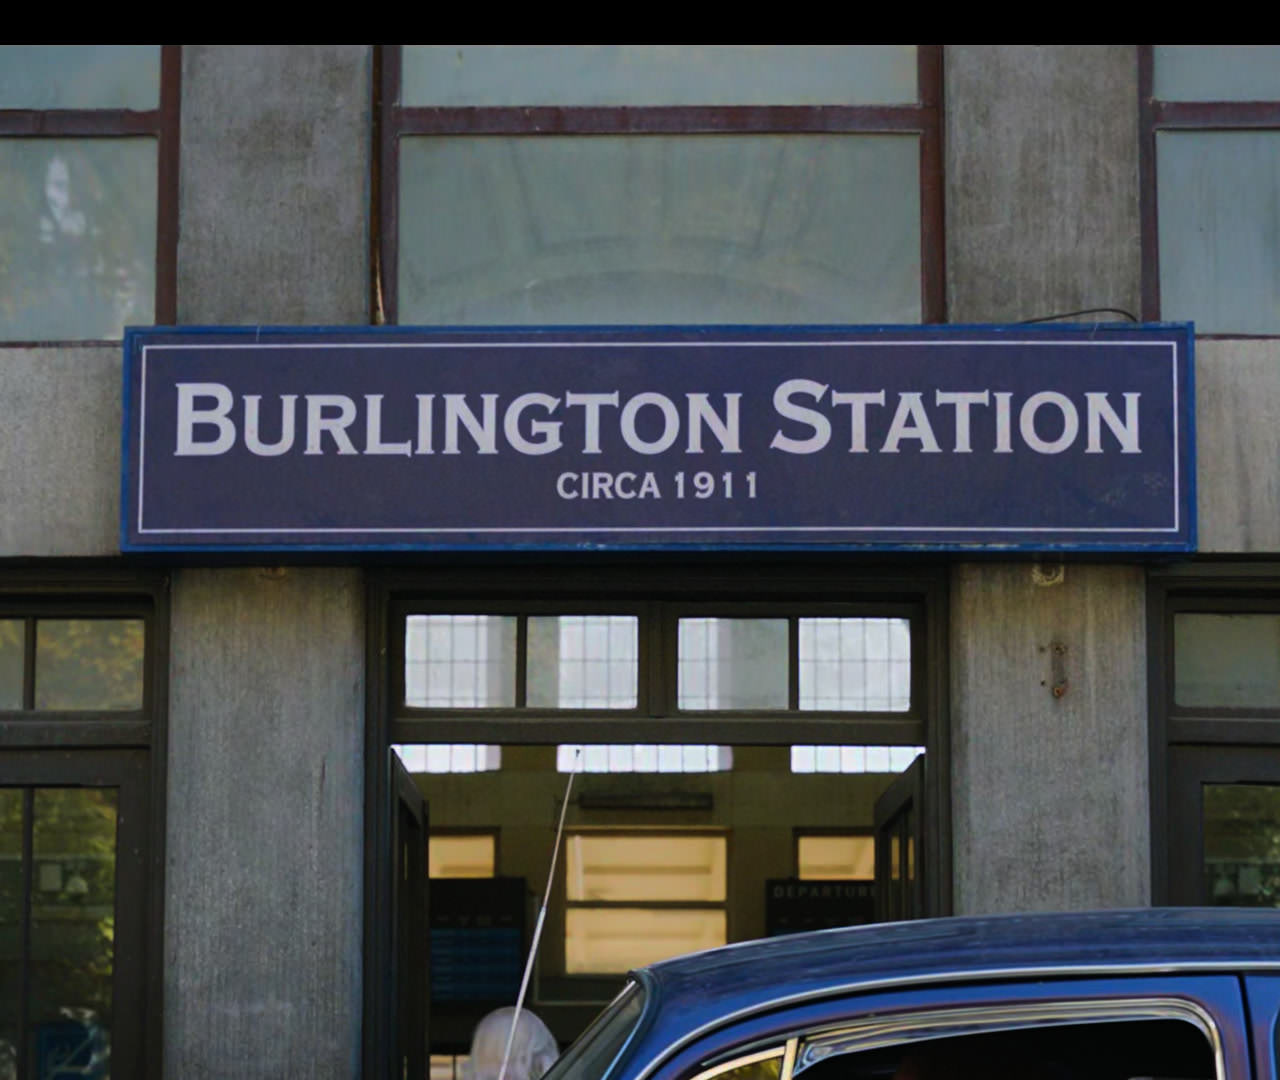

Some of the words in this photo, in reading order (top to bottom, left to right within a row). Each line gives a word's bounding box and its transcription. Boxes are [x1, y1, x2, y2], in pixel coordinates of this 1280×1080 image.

[173, 382, 741, 457] BURLINGTON
[769, 378, 1142, 455] STATION
[556, 471, 662, 500] CIRCA
[674, 471, 757, 499] 1911
